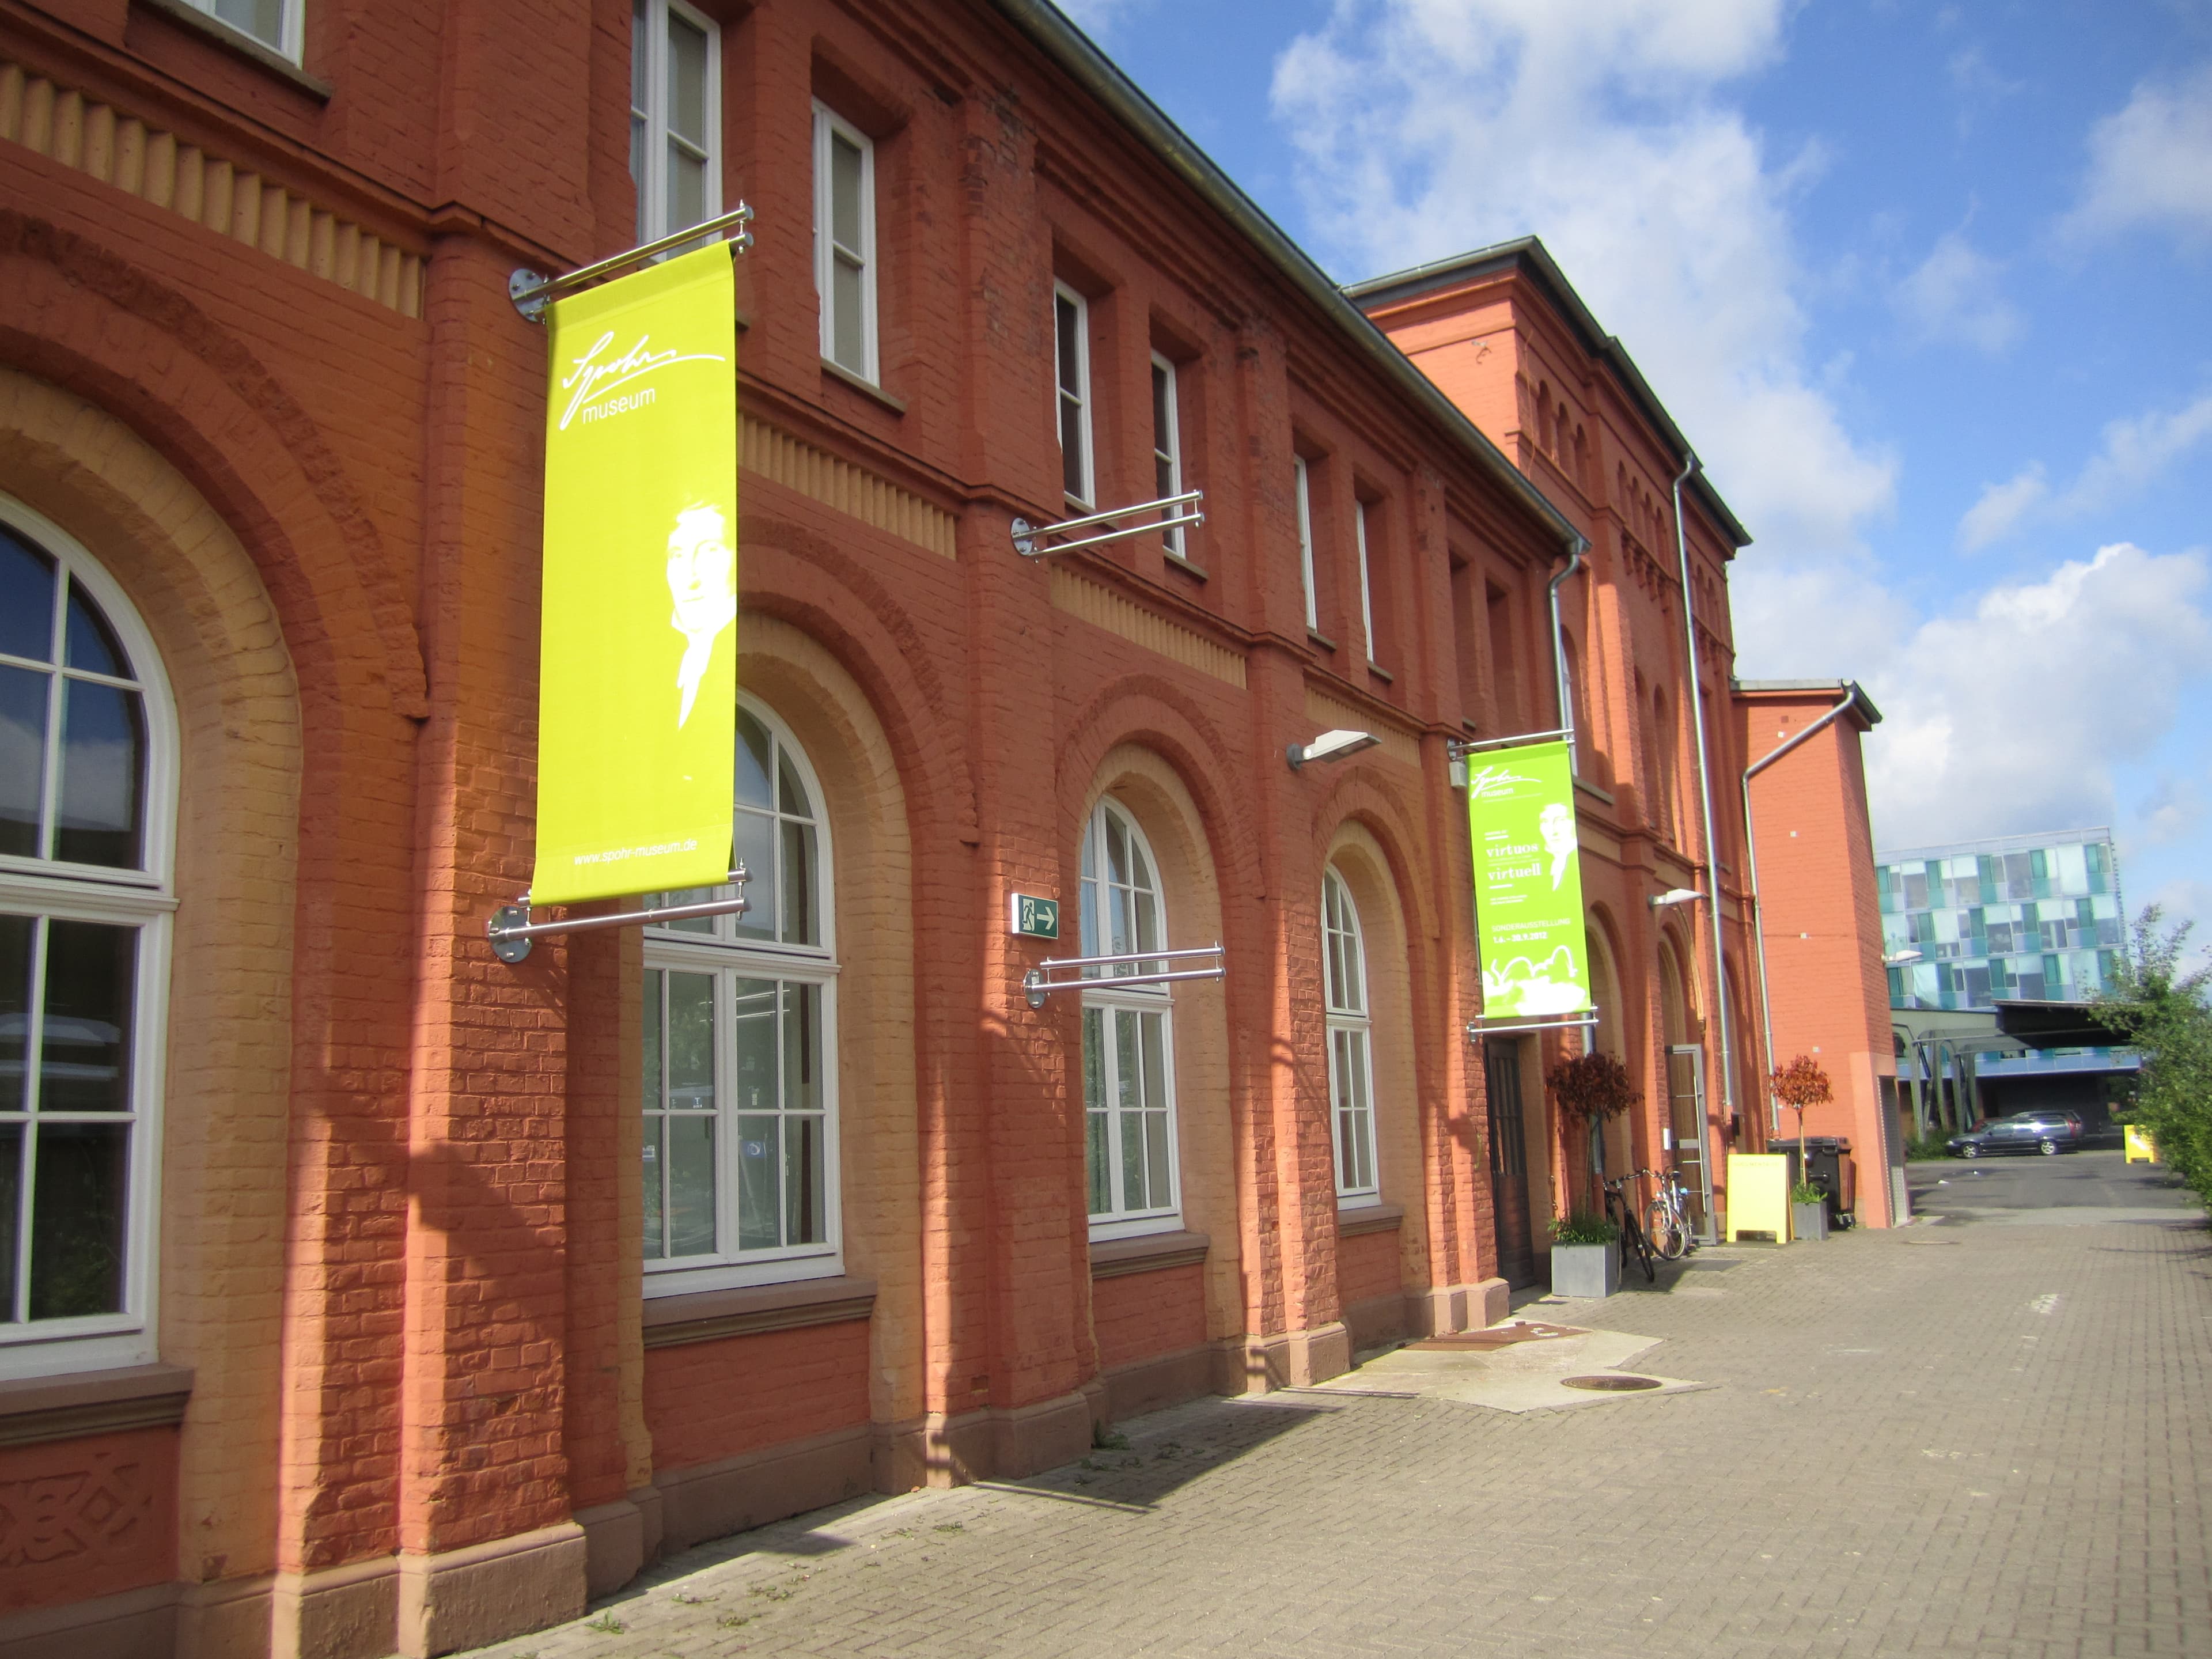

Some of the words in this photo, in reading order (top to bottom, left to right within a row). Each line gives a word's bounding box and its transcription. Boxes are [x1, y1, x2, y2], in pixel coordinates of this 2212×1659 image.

[582, 388, 656, 424] museum
[1482, 787, 1514, 797] museum
[574, 839, 698, 865] www.spohr-museum.de
[1486, 843, 1539, 857] virtuos
[1488, 863, 1542, 881] virtuell
[1491, 918, 1571, 932] SONDERAUSSTELLUNG
